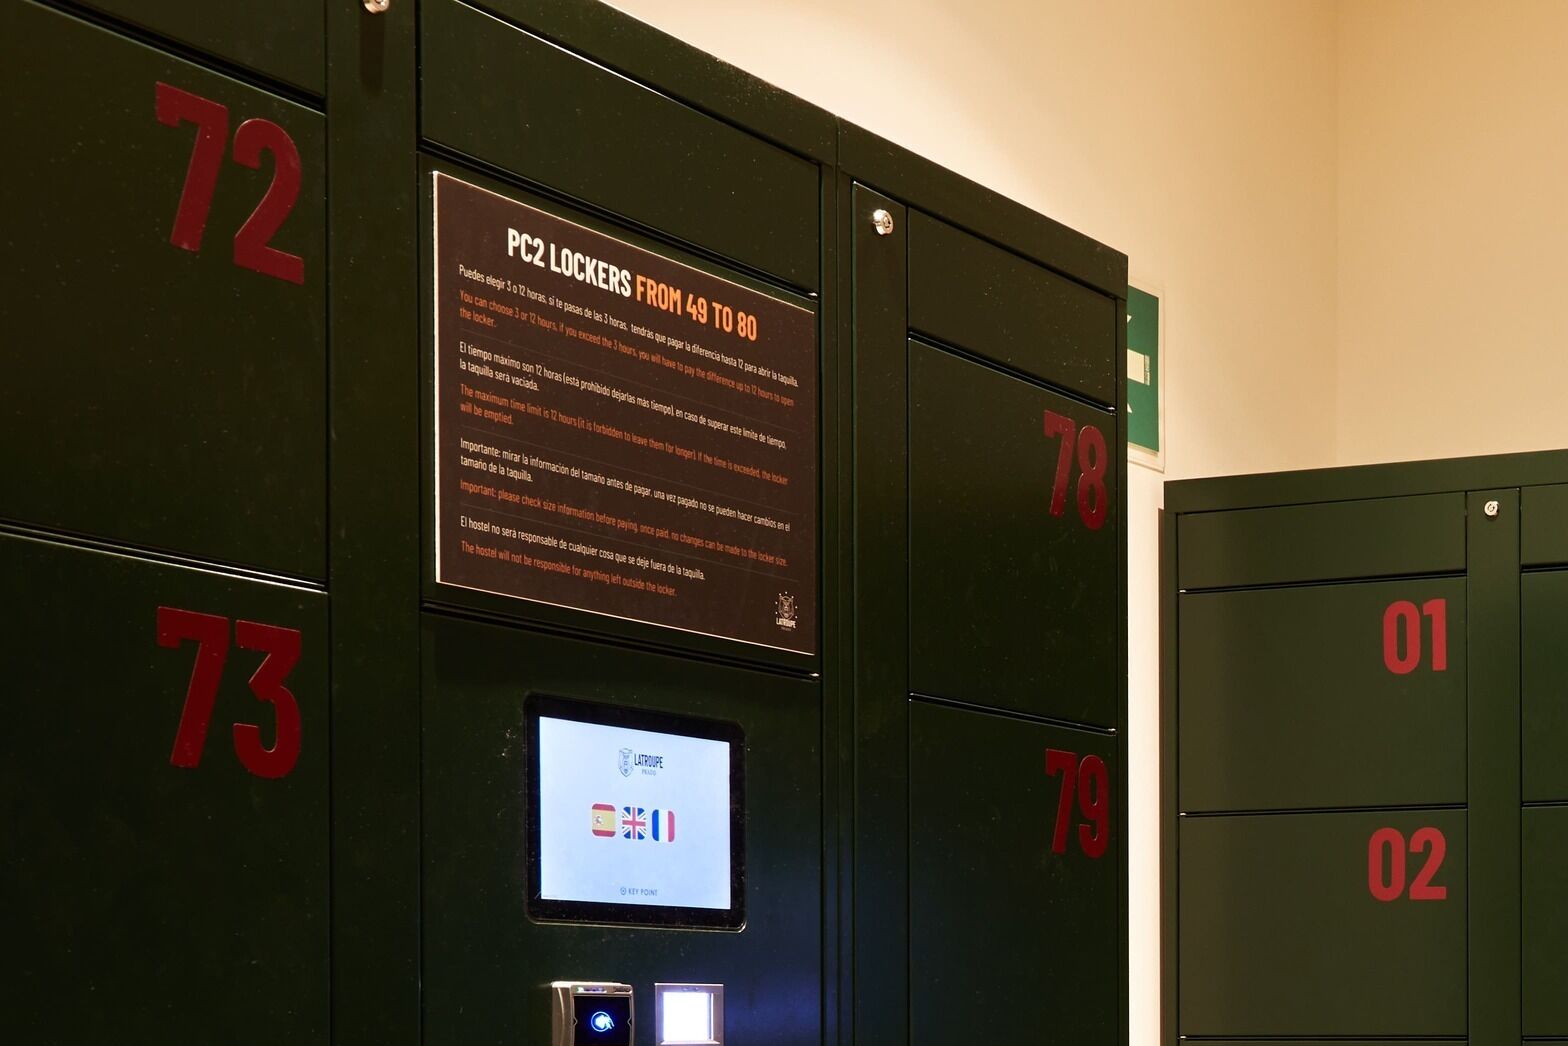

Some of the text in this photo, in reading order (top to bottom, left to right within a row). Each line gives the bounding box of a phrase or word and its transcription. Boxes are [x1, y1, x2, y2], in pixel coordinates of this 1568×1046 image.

[157, 84, 304, 284] 72
[458, 263, 485, 283] Puedes
[485, 274, 506, 291] elegir
[506, 279, 512, 292] 3
[512, 284, 518, 294] o
[518, 283, 526, 297] 12
[548, 295, 555, 306] si
[555, 297, 563, 309] te
[563, 301, 584, 316] pasas
[583, 307, 593, 319] de
[592, 309, 603, 323] las
[603, 312, 609, 325] 3
[654, 332, 667, 344] que
[666, 336, 685, 350] pagar
[684, 340, 691, 352] la
[691, 343, 721, 362] diferencia
[720, 352, 738, 367] hasta
[737, 357, 744, 370] 12
[744, 362, 758, 374] para
[757, 366, 771, 378] abrir
[771, 369, 778, 381] la
[507, 227, 758, 342] PC2 LOCKERS FROM 49 TO 80
[460, 455, 488, 471] tamaño
[488, 461, 498, 474] de
[498, 463, 506, 476] la
[501, 449, 521, 463] mirar
[522, 453, 529, 466] la
[529, 455, 570, 476] información
[569, 466, 581, 478] del
[580, 469, 606, 485] tamaño
[606, 477, 624, 490] antes
[624, 480, 633, 492] de
[653, 490, 666, 501] una
[665, 493, 677, 503] vez
[676, 495, 699, 509] pagado
[699, 501, 708, 511] no
[707, 503, 715, 513] se
[715, 505, 737, 518] pueden
[736, 509, 753, 522] hacer
[753, 515, 777, 529] cambios
[776, 521, 785, 531] en
[784, 522, 791, 532] el
[1045, 411, 1108, 529] 78
[1384, 601, 1447, 675] 01
[159, 608, 301, 778] 73
[634, 753, 663, 768] LATROUPE
[1047, 750, 1108, 858] 79
[628, 888, 657, 896] KEY POINT
[1369, 828, 1448, 902] 02
